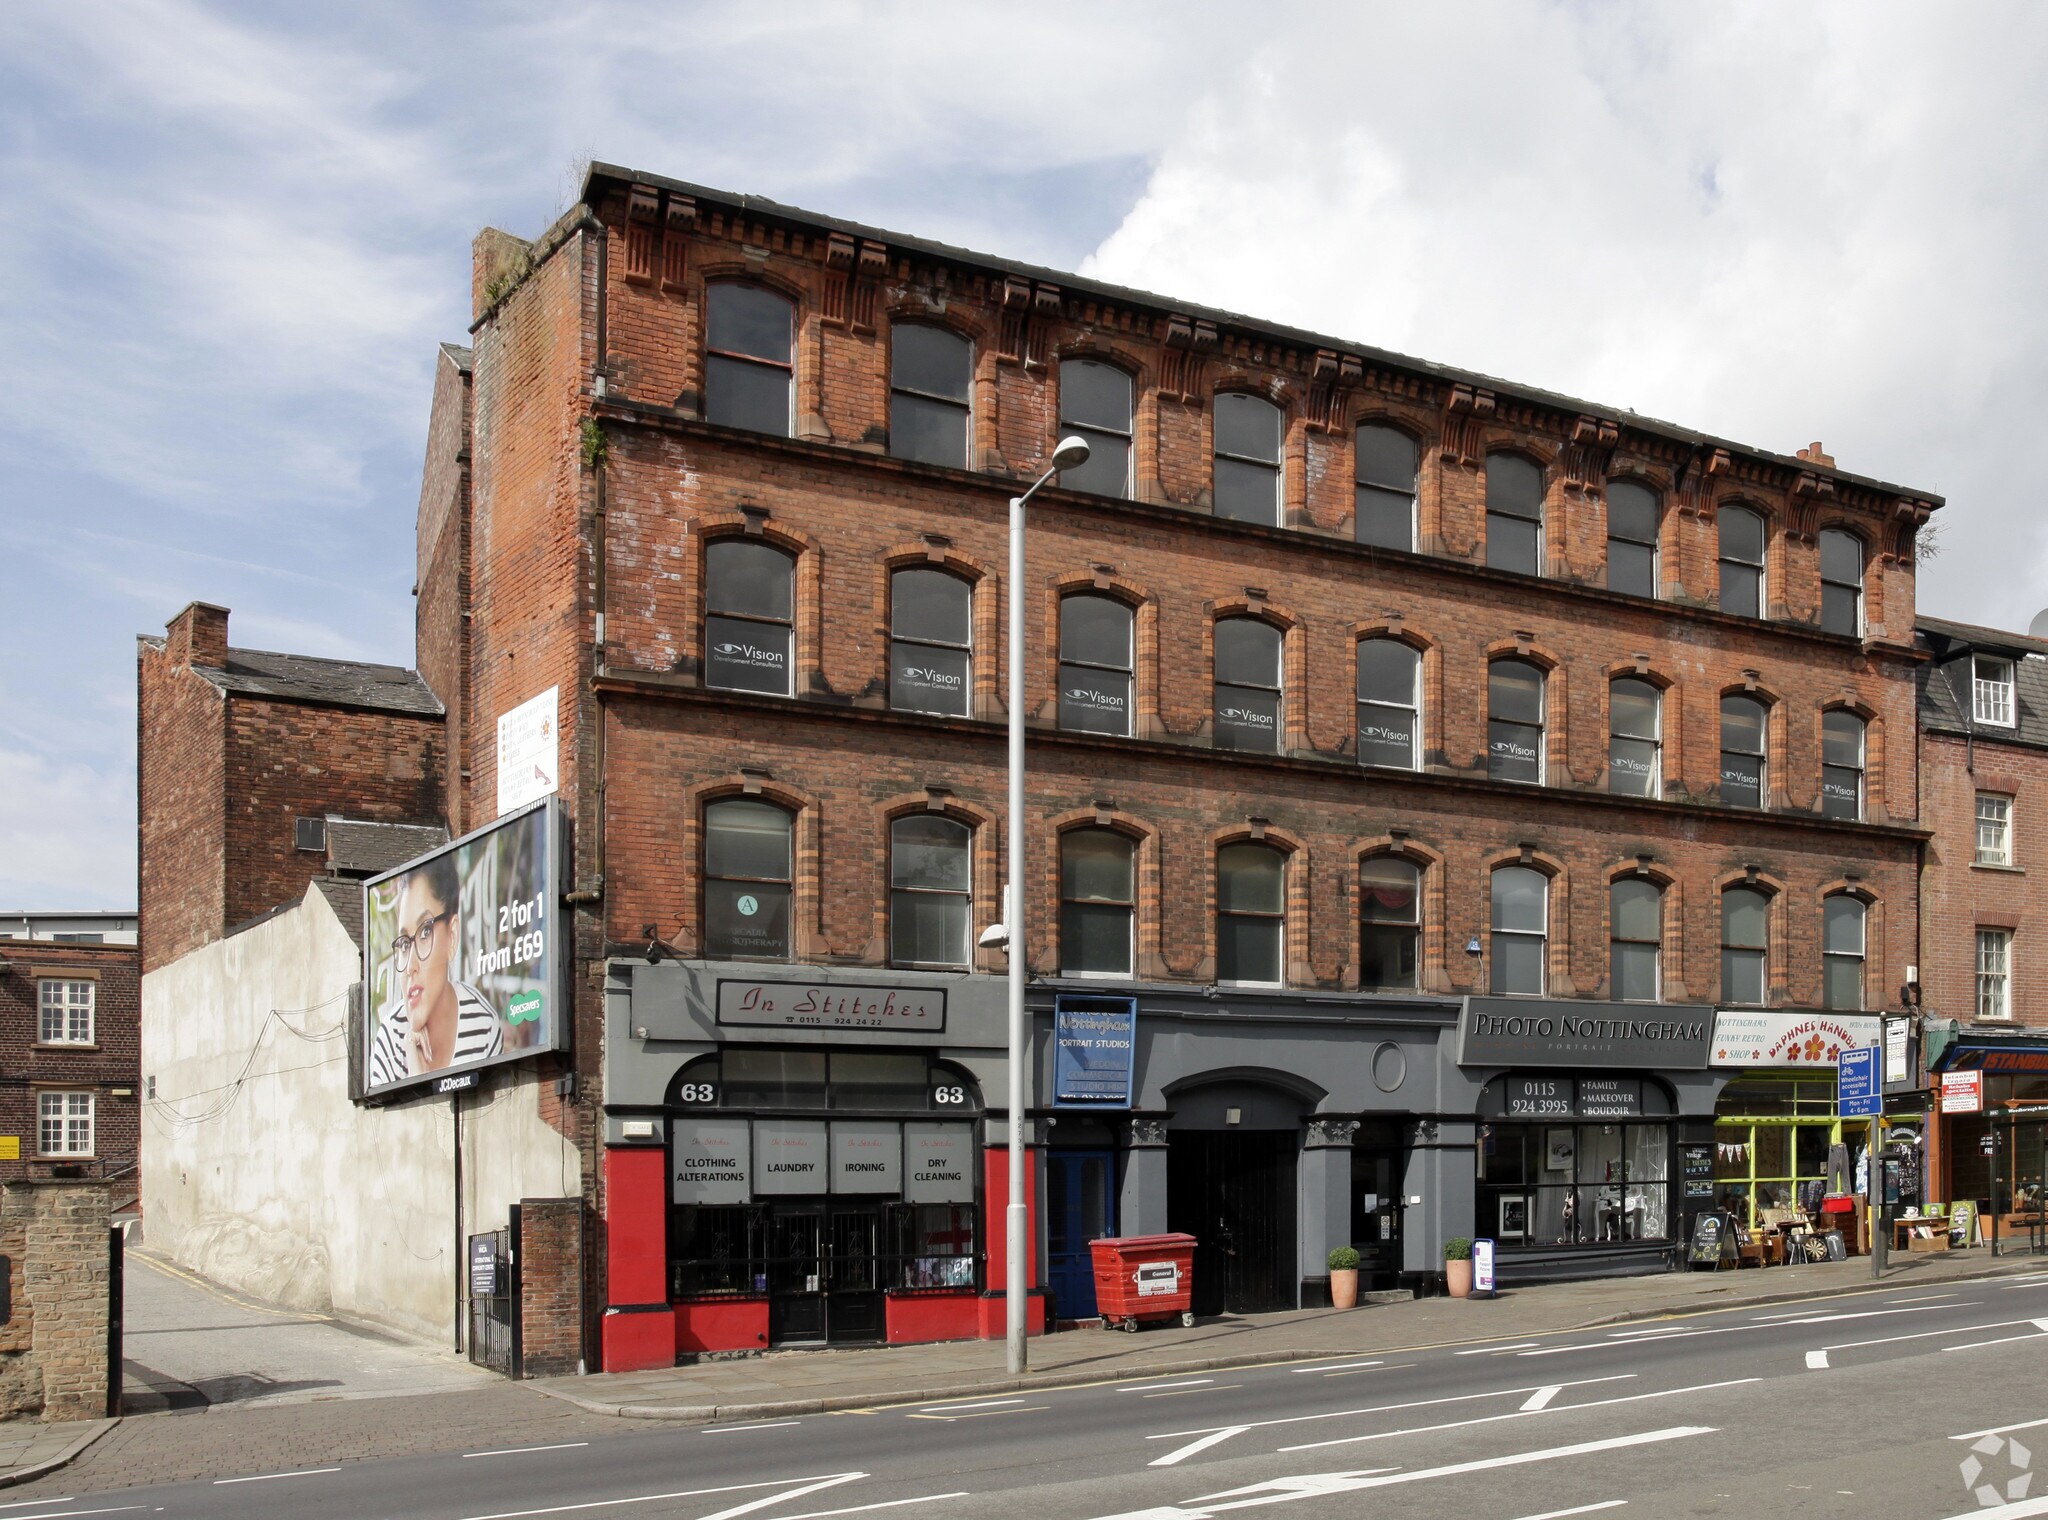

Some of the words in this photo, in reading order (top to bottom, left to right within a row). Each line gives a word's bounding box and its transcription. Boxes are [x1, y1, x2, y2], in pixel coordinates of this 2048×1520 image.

[742, 644, 783, 662] Vision
[751, 659, 783, 669] Consultants
[924, 668, 961, 684] Vision
[1089, 689, 1123, 706] Vision
[1241, 709, 1273, 723] Vision
[1380, 727, 1409, 741] Vision
[1508, 742, 1536, 757] Vision
[1735, 771, 1758, 784] Vision
[1834, 784, 1855, 796] Vision
[741, 898, 754, 912] A
[499, 905, 509, 933] 2
[511, 899, 534, 929] for
[536, 891, 543, 919] 1
[729, 927, 768, 938] ARCADIA
[476, 946, 511, 977] from
[513, 930, 543, 965] £69
[510, 998, 540, 1018] Specsavers
[738, 987, 775, 1011] In
[792, 988, 927, 1017] Stitches
[799, 1016, 821, 1024] 0115
[834, 1017, 851, 1025] 924
[870, 1018, 882, 1026] 22
[1060, 1015, 1131, 1035] Nottingham
[1473, 1012, 1553, 1037] PHOTO
[1558, 1014, 1705, 1042] NOTTINGHAM
[1717, 1017, 1767, 1027] NOTTINGHAMS
[1059, 1039, 1093, 1047] PORTRAIT
[1096, 1040, 1130, 1048] STUDIOS
[1715, 1034, 1741, 1043] FUNKY
[1742, 1035, 1766, 1043] RETRO
[1768, 1020, 1816, 1058] DAPHNES
[1548, 1043, 1613, 1051] PORTRAIT
[1728, 1049, 1751, 1059] SHOP
[439, 1075, 472, 1093] JCDecaux
[1841, 1075, 1868, 1083] Wheelchair
[1524, 1082, 1555, 1096] 0115
[1587, 1081, 1618, 1090] FAMILY
[1841, 1082, 1867, 1090] accessible
[681, 1083, 714, 1102] 63
[935, 1086, 964, 1103] 63
[1587, 1094, 1634, 1103] MAKEOVER
[1512, 1099, 1536, 1113] 924
[1538, 1100, 1568, 1113] 3995
[1587, 1106, 1630, 1115] BOUDOIR
[684, 1158, 736, 1168] CLOTHING
[767, 1163, 815, 1173] LAUNDRY
[845, 1163, 885, 1172] IRONING
[928, 1159, 947, 1168] DRY
[677, 1172, 744, 1182] ALTERATIONS
[914, 1172, 961, 1182] CLEANING
